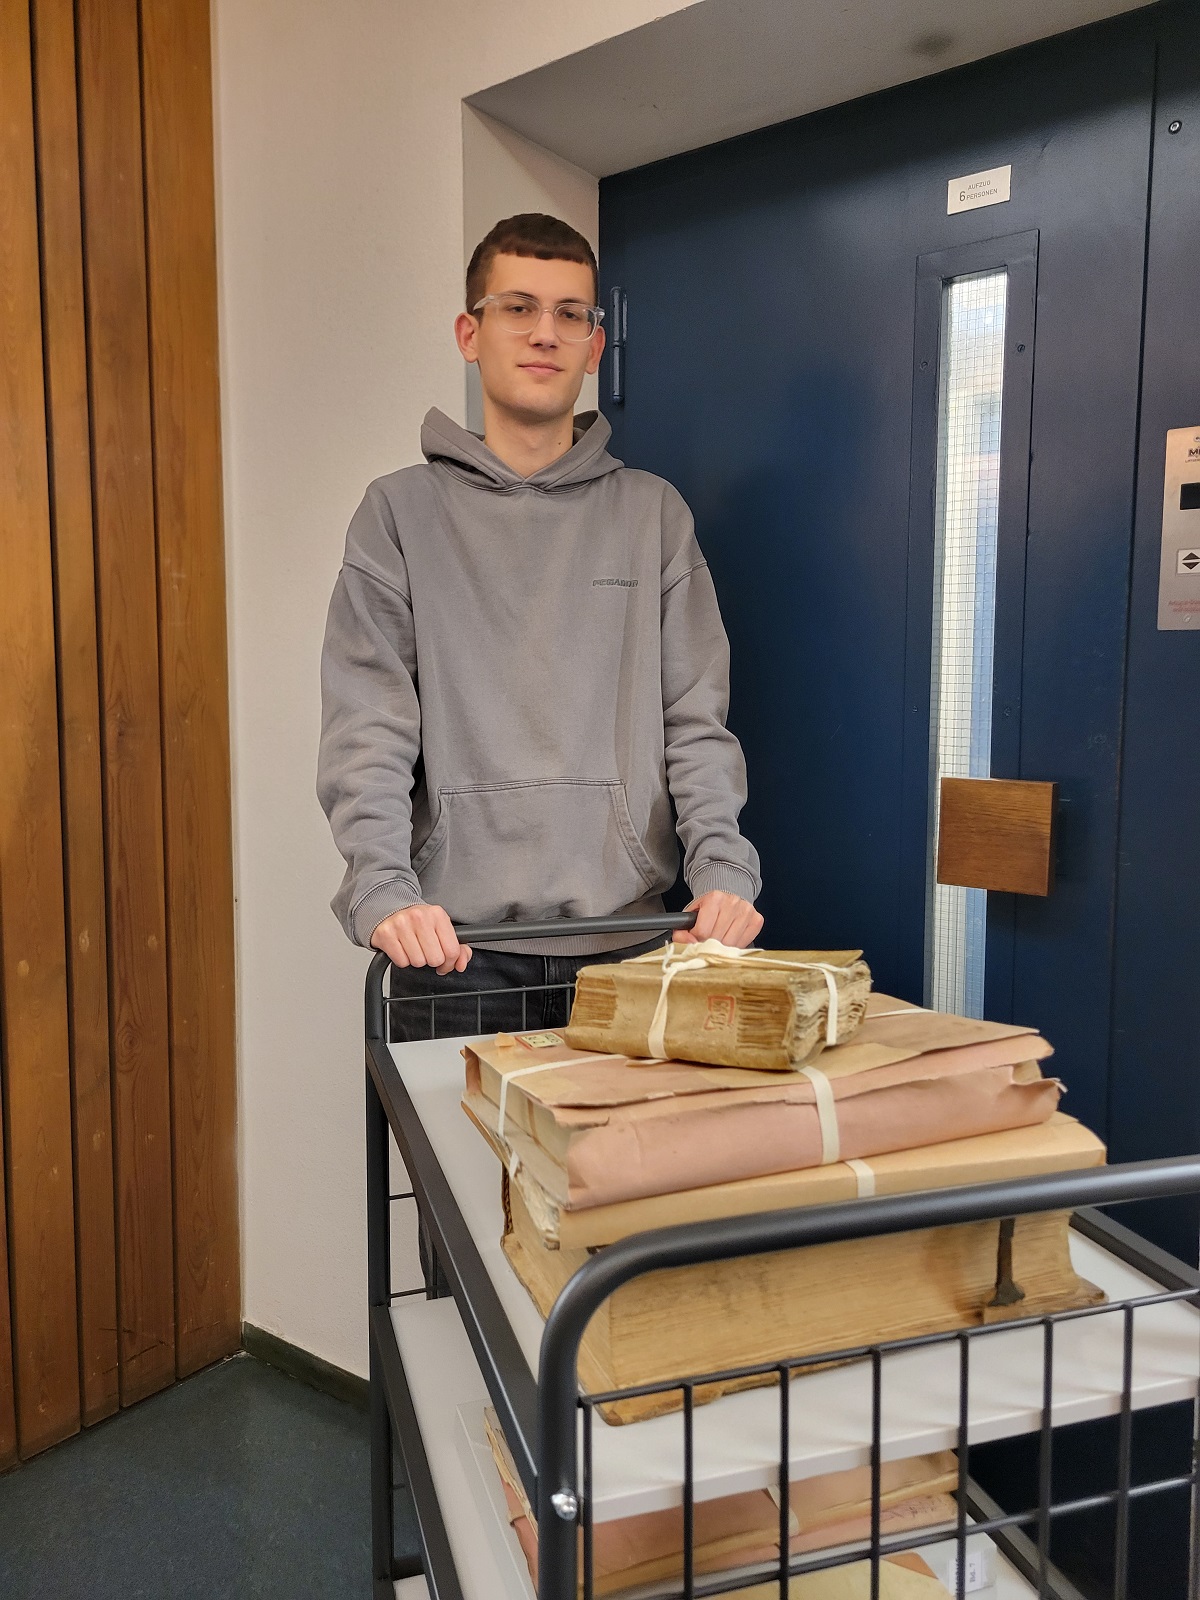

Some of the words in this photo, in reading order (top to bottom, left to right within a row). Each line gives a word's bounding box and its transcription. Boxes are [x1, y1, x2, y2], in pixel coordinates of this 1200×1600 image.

[967, 180, 991, 191] AUFZUG
[959, 190, 966, 202] 6
[966, 188, 998, 201] PERSONEN
[1188, 448, 1200, 457] M
